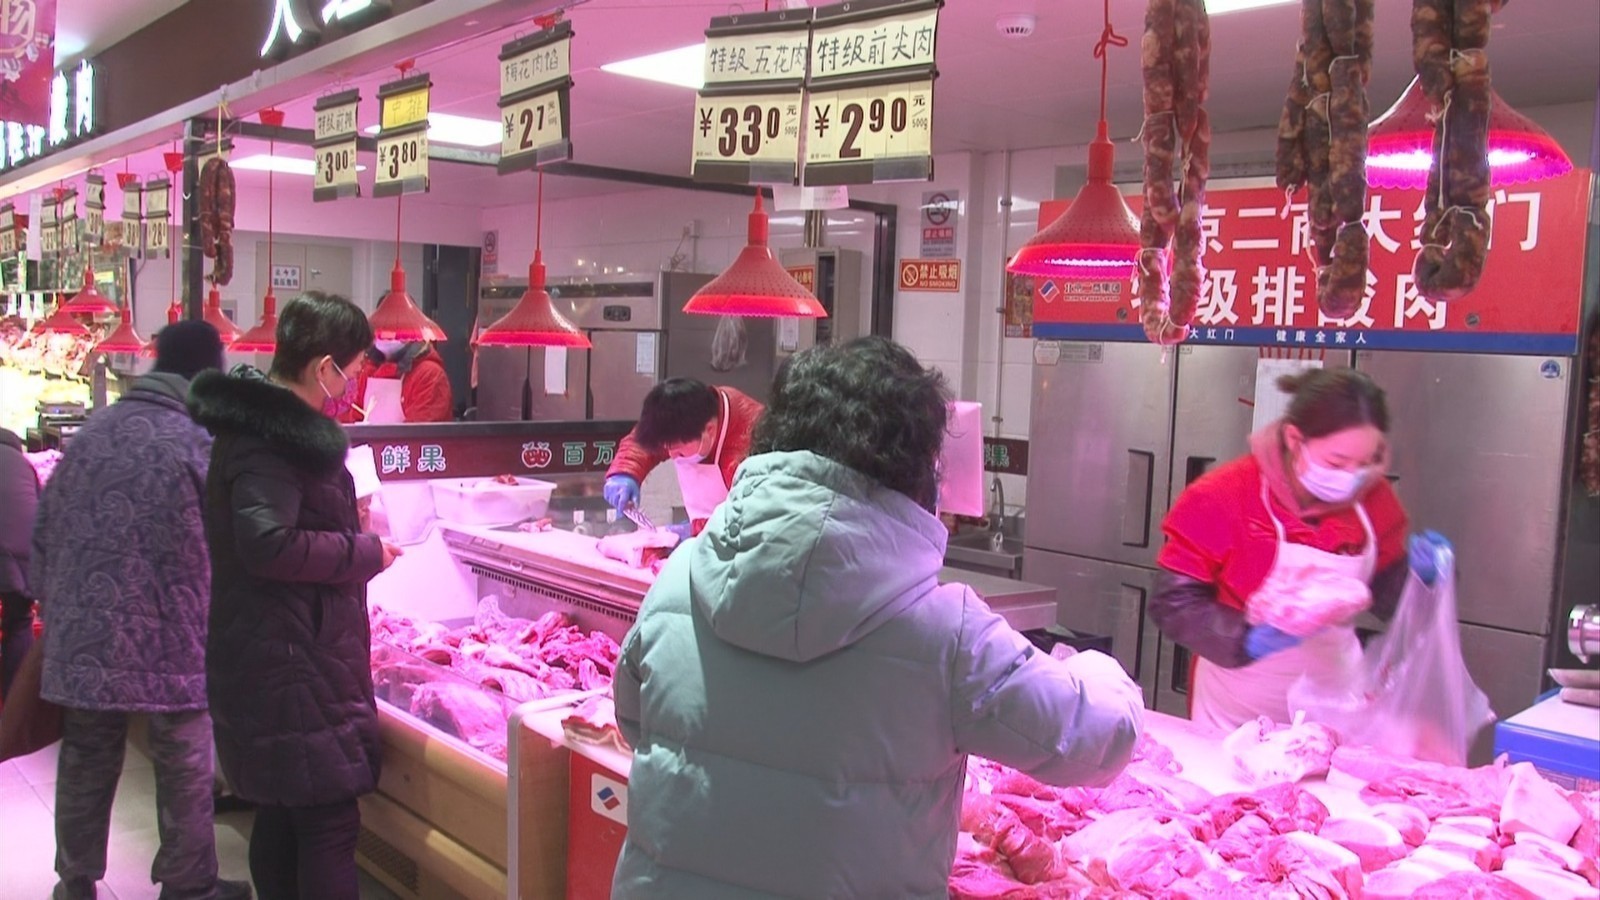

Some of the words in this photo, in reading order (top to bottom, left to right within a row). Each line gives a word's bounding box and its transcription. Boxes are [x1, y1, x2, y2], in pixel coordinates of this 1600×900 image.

[710, 42, 808, 74] 特级五花肉
[817, 25, 932, 72] 特级前尖肉
[1201, 189, 1541, 256] 京二大门
[920, 264, 958, 279] 禁止吸烟
[1131, 265, 1447, 330] 级排肉
[1189, 328, 1235, 340] 大红门
[1276, 329, 1367, 344] 健康全家人
[381, 444, 446, 473] 鲜果
[562, 441, 616, 466] 百万
[984, 443, 1010, 468] 果
